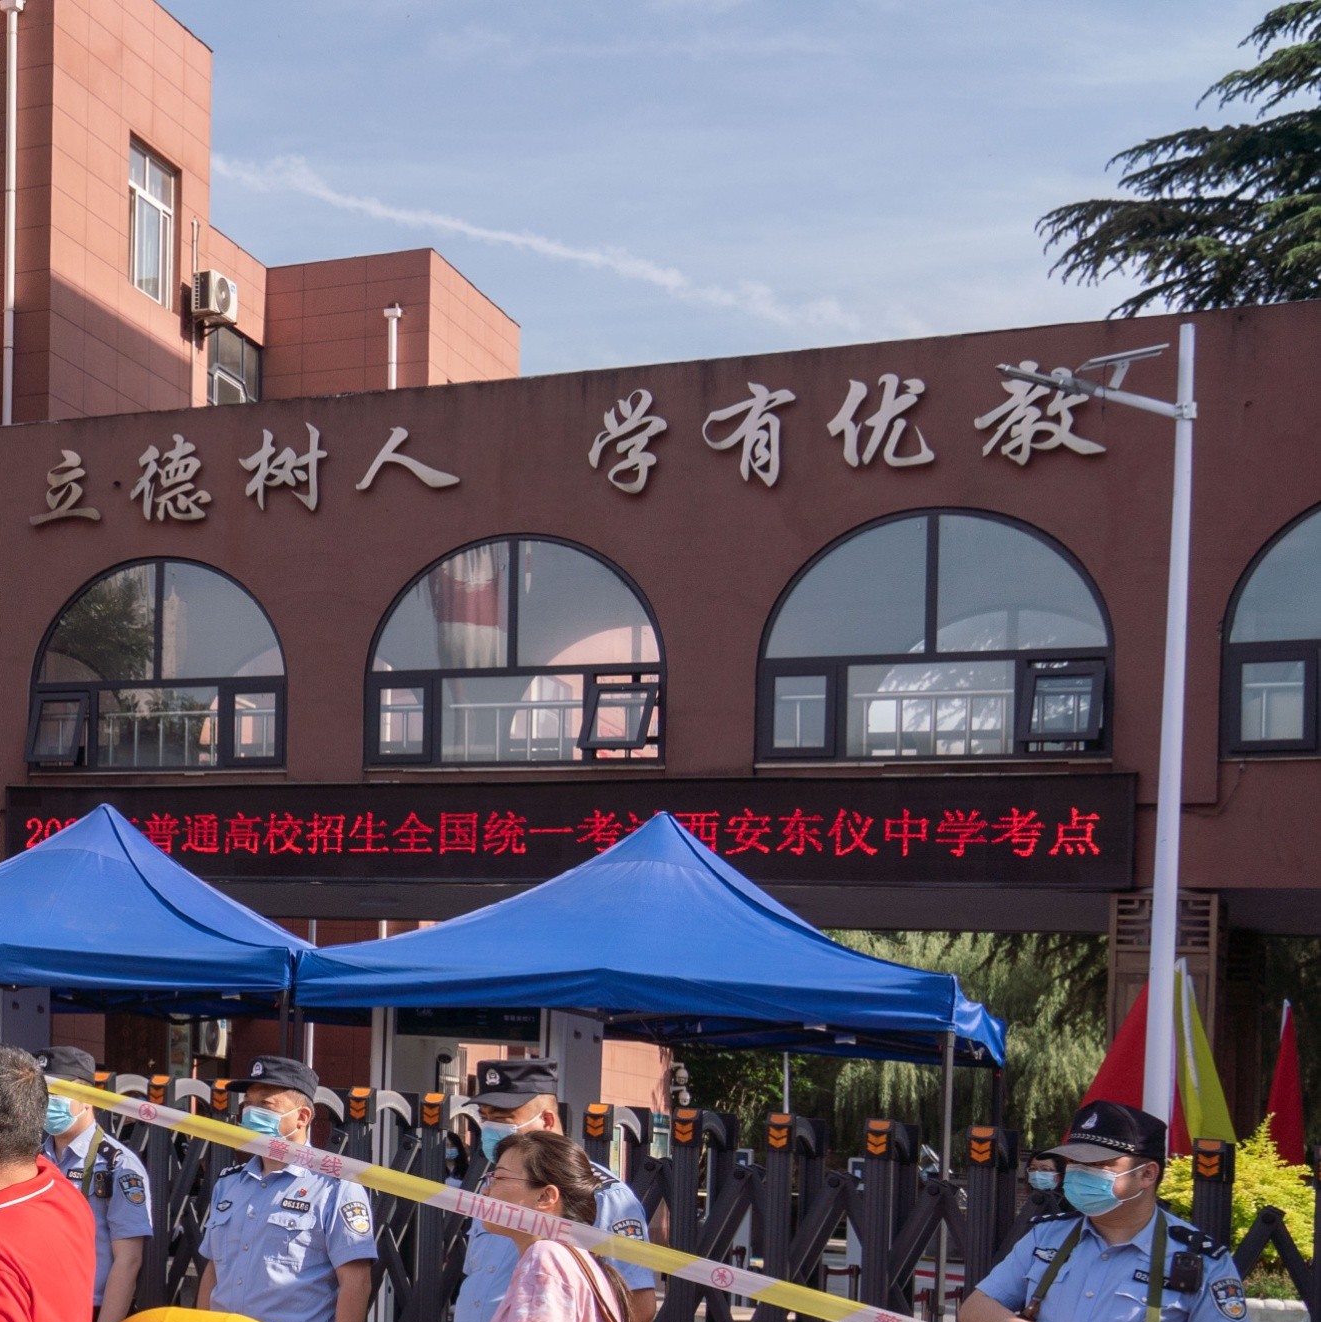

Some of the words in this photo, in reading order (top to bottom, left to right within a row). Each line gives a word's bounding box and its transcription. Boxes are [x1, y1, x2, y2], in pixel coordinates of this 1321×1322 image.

[588, 361, 1107, 494] 学有优教
[29, 422, 460, 522] 立德树人
[268, 1138, 343, 1177] 警戒线
[455, 1191, 574, 1243] LIMITLINE
